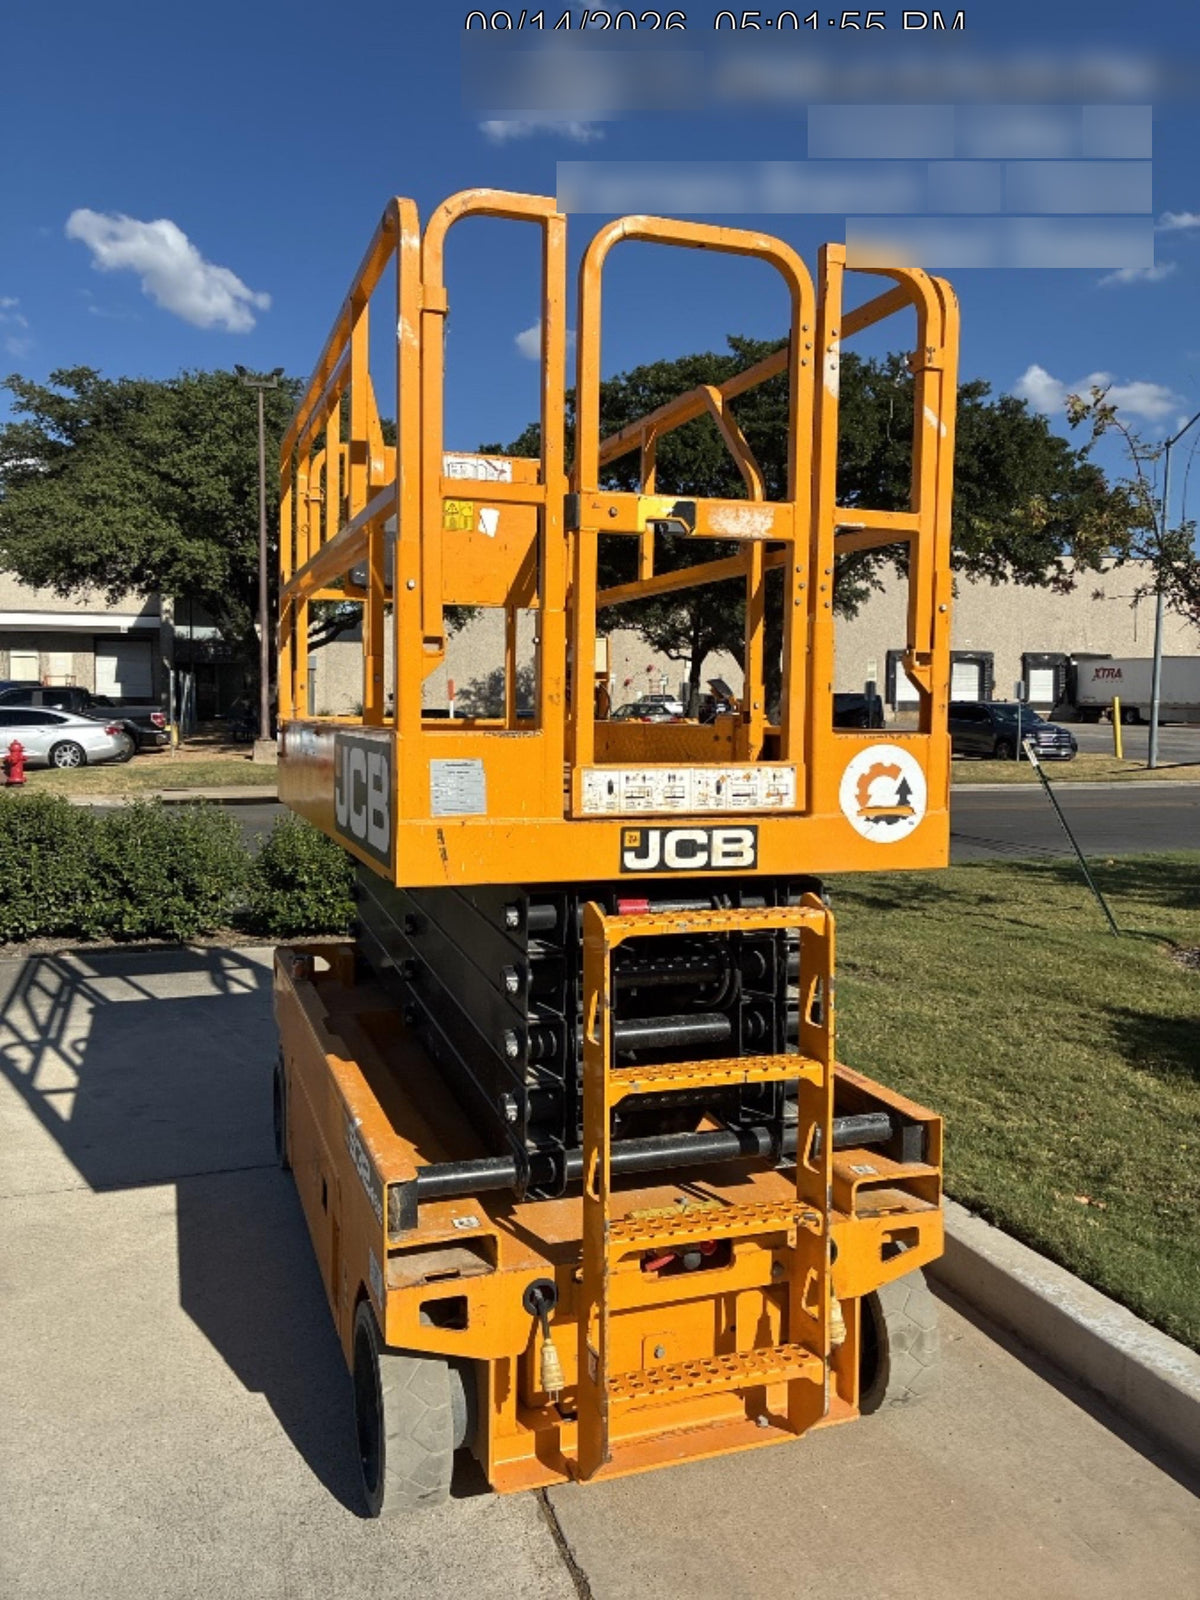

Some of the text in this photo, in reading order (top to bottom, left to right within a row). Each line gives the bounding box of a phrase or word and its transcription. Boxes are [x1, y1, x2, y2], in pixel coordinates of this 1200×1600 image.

[1092, 667, 1123, 681] XTRA
[335, 745, 390, 854] JCB
[623, 828, 755, 870] JCB
